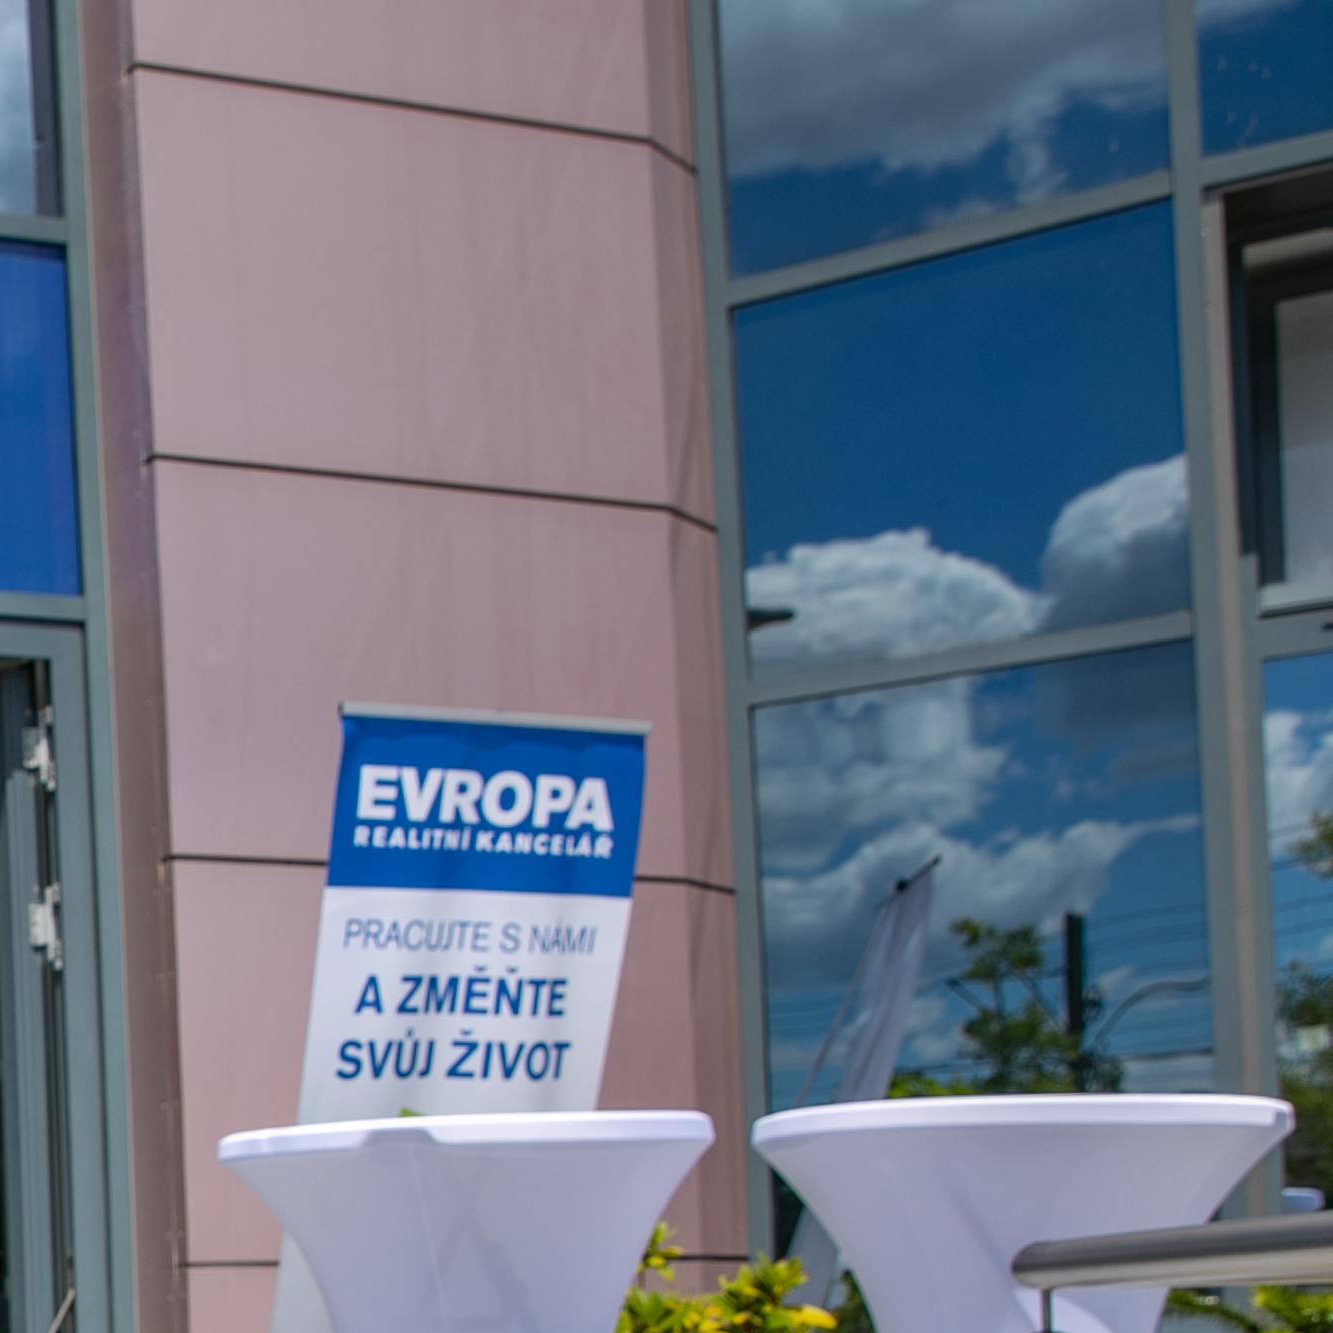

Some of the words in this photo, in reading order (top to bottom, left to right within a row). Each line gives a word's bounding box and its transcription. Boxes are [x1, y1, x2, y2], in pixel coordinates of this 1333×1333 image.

[355, 763, 614, 833] EVROPA
[353, 825, 471, 852] REALITNÍ
[475, 830, 614, 859] KANCELÁŘ
[343, 917, 493, 953] PRACUJTE
[499, 921, 522, 955] S
[528, 918, 598, 956] NÁMI
[354, 975, 384, 1015] A
[395, 965, 569, 1018] ZMĚŇTE
[336, 1028, 436, 1081] SVŮJ
[446, 1030, 572, 1082] ŽIVOT
